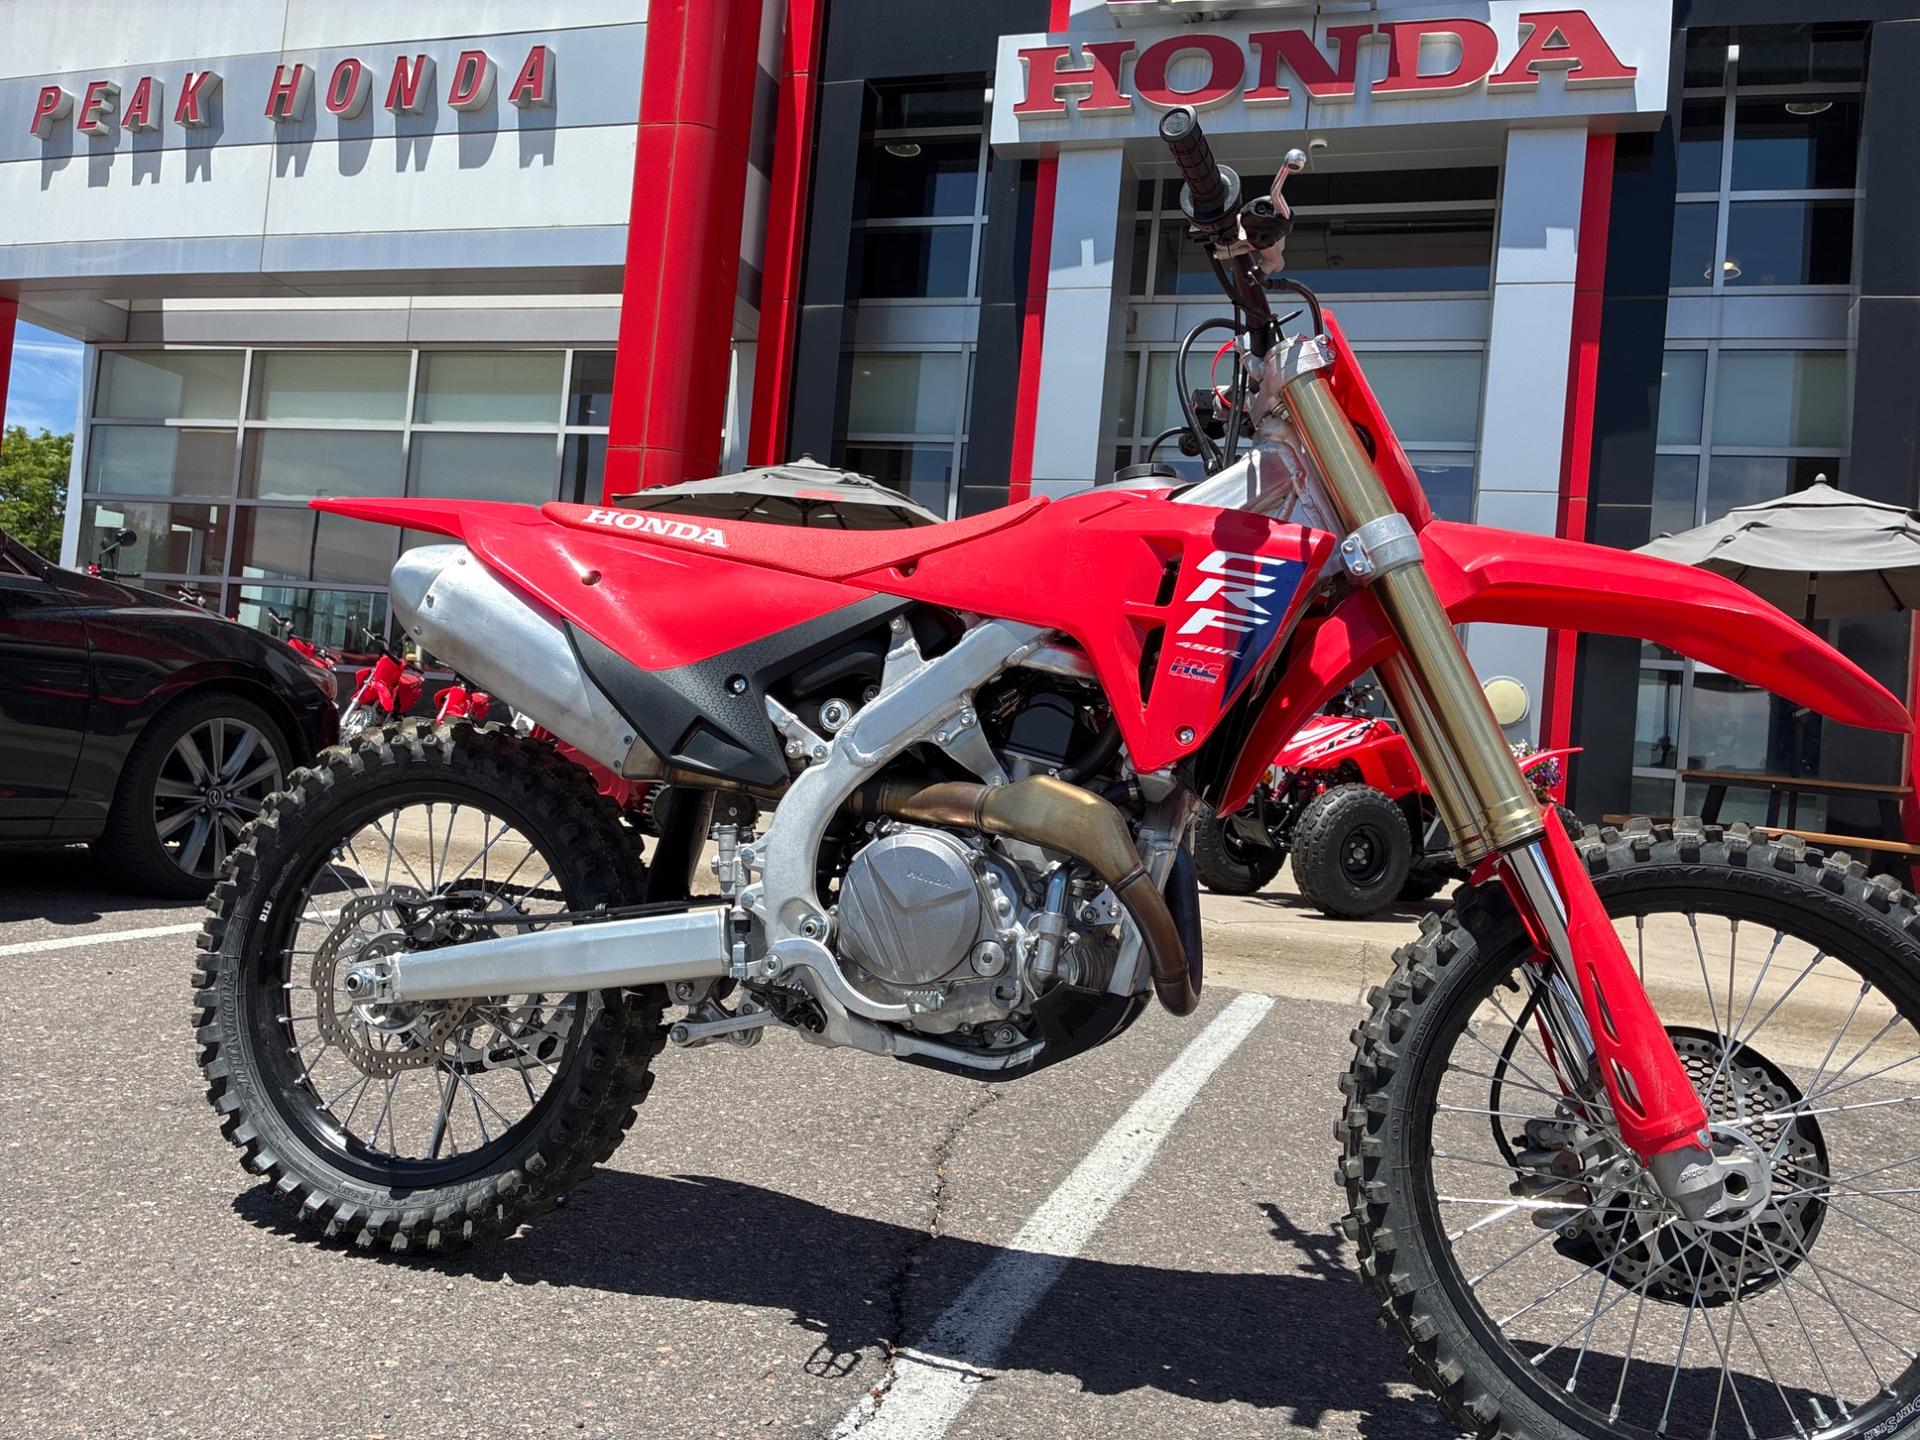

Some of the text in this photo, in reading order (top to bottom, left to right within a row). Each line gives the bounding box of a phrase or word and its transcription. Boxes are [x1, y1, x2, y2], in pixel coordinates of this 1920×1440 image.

[31, 45, 555, 140] PEAK HONDA
[1013, 9, 1637, 120] HONDA
[582, 509, 730, 548] HONDA
[1176, 550, 1288, 635] CRF
[1169, 656, 1224, 680] HRC
[1175, 641, 1243, 660] 450R
